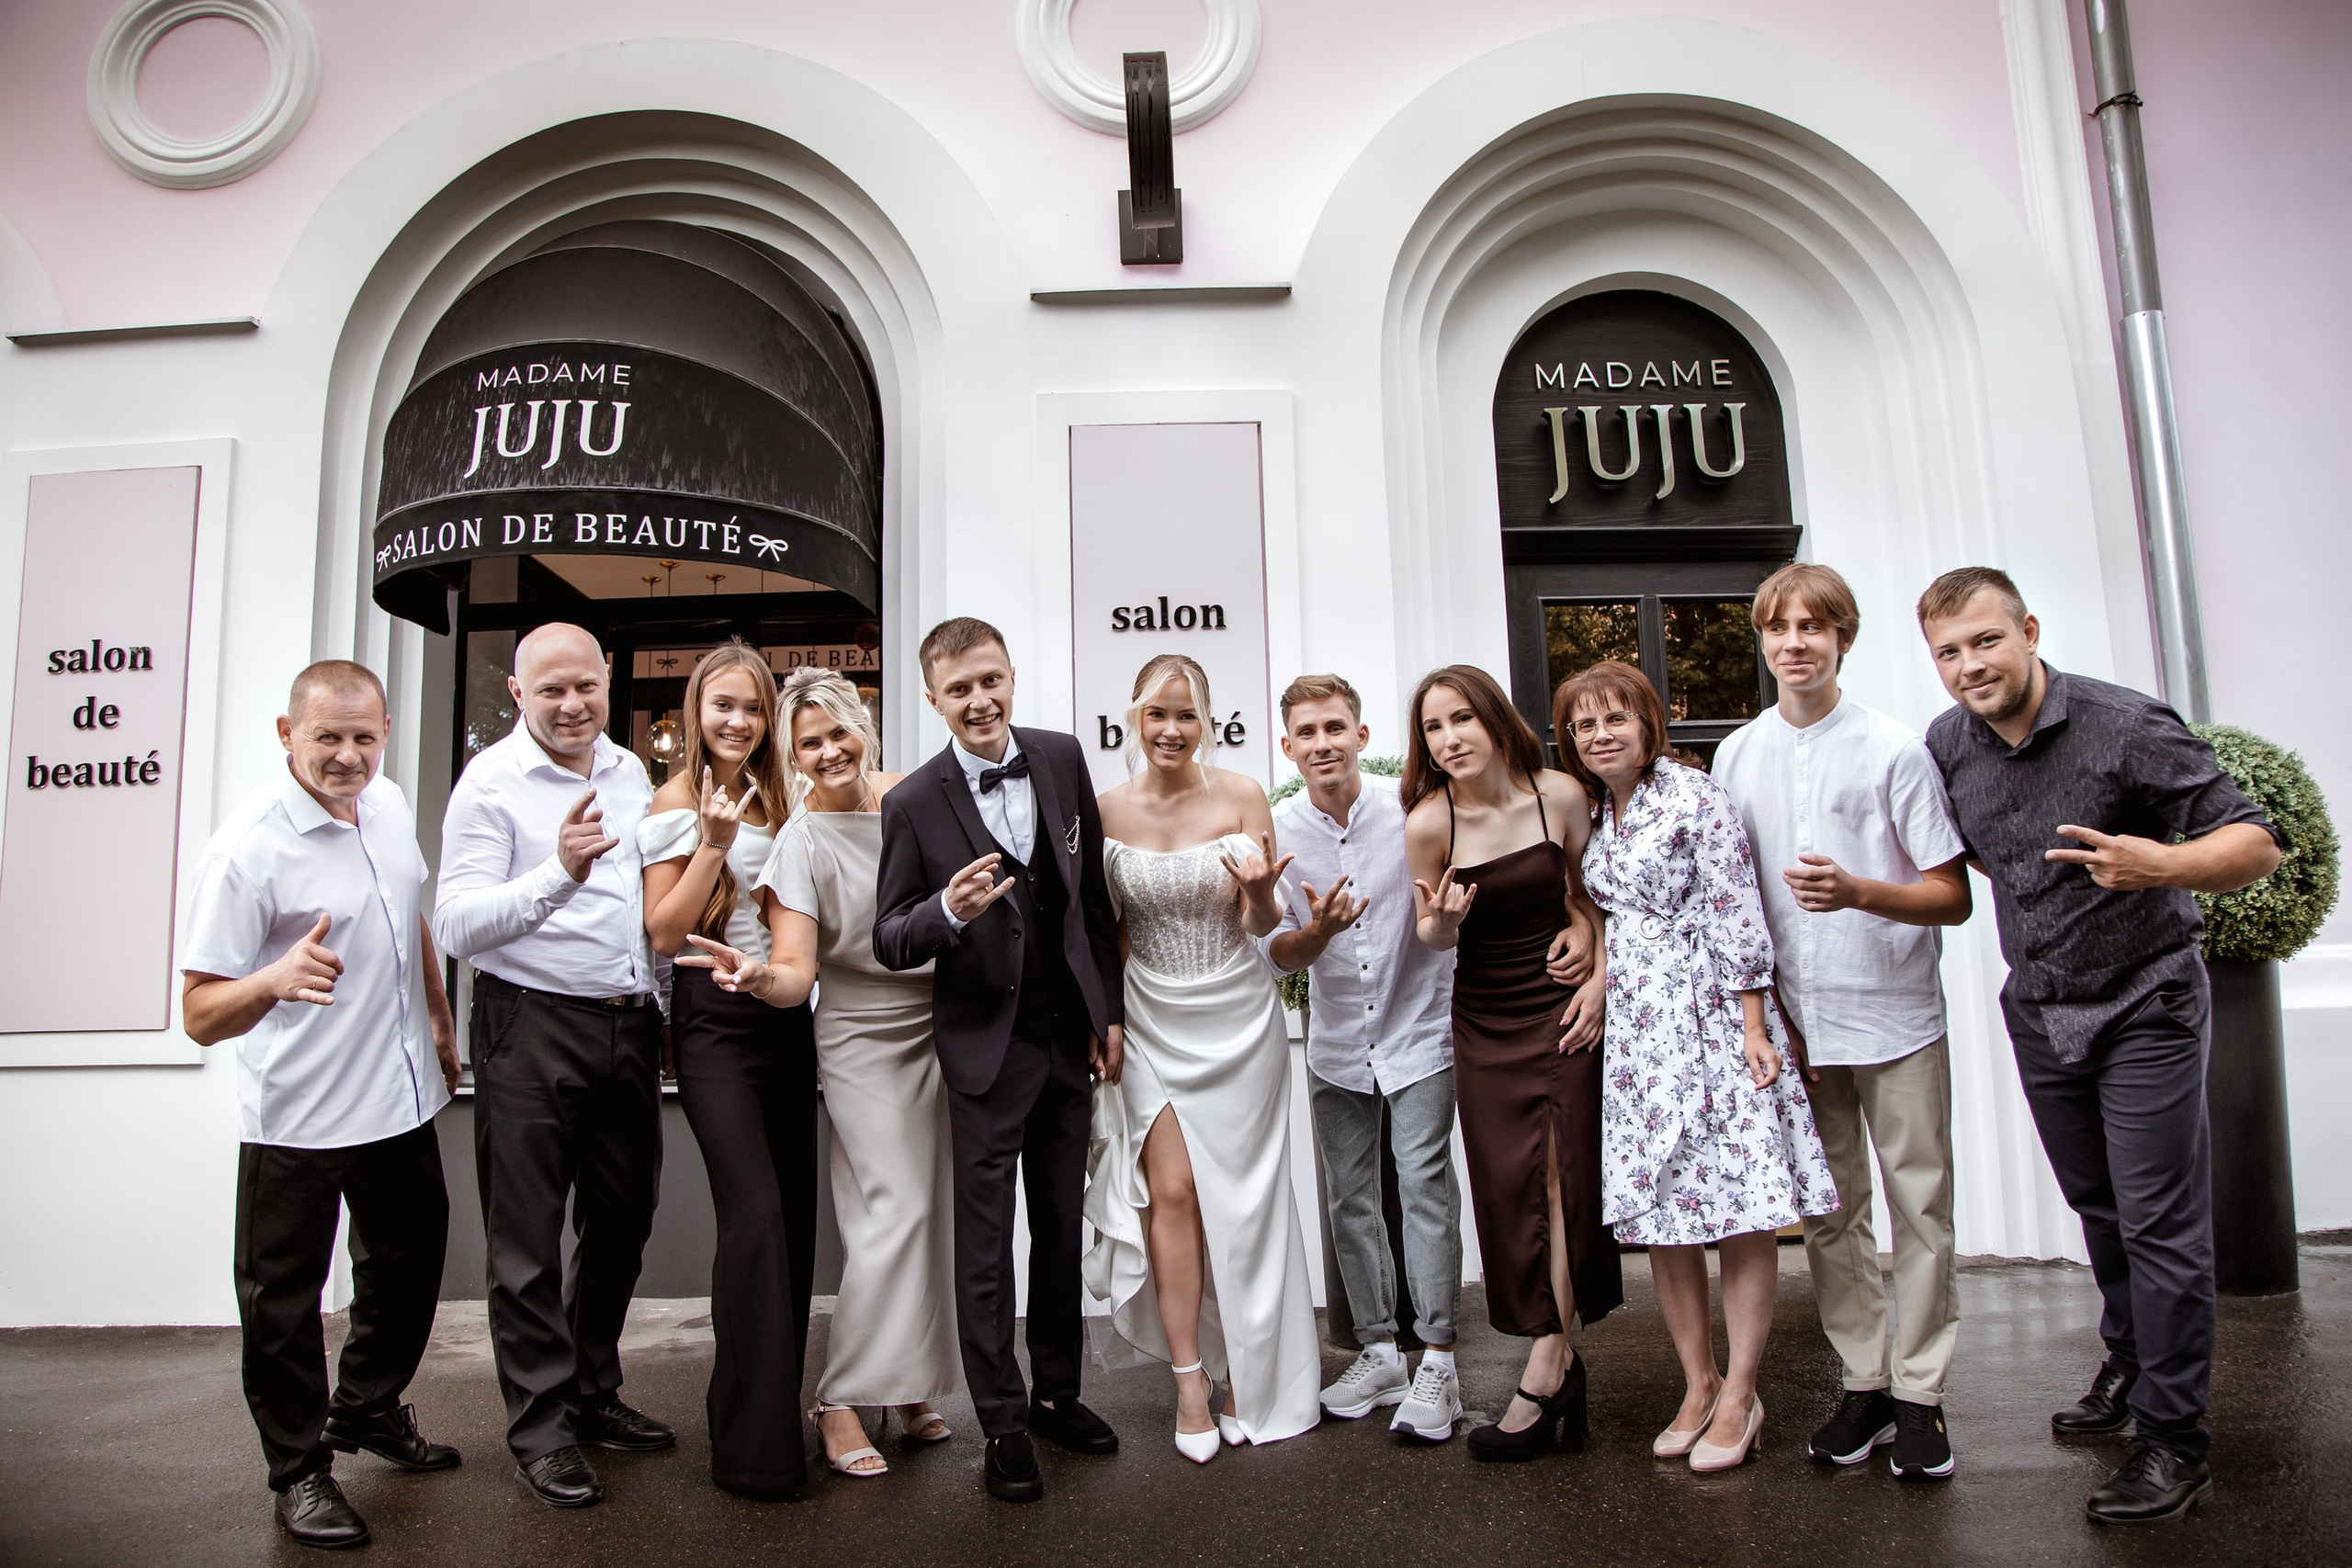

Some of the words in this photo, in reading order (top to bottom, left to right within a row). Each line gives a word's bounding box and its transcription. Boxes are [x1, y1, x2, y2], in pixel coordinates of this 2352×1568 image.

[477, 362, 631, 391] MADAME
[1535, 359, 1733, 389] MADAME
[464, 400, 632, 479] JUJU
[1544, 402, 1746, 505] JUJU
[392, 517, 483, 563] SALON
[502, 513, 554, 545] DE
[574, 513, 741, 554] BEAUTÉ
[1112, 595, 1227, 632] salon
[48, 638, 153, 675] salon
[788, 650, 818, 667] DE
[829, 649, 875, 666] BEA
[73, 695, 120, 730] de
[27, 750, 161, 790] beauté
